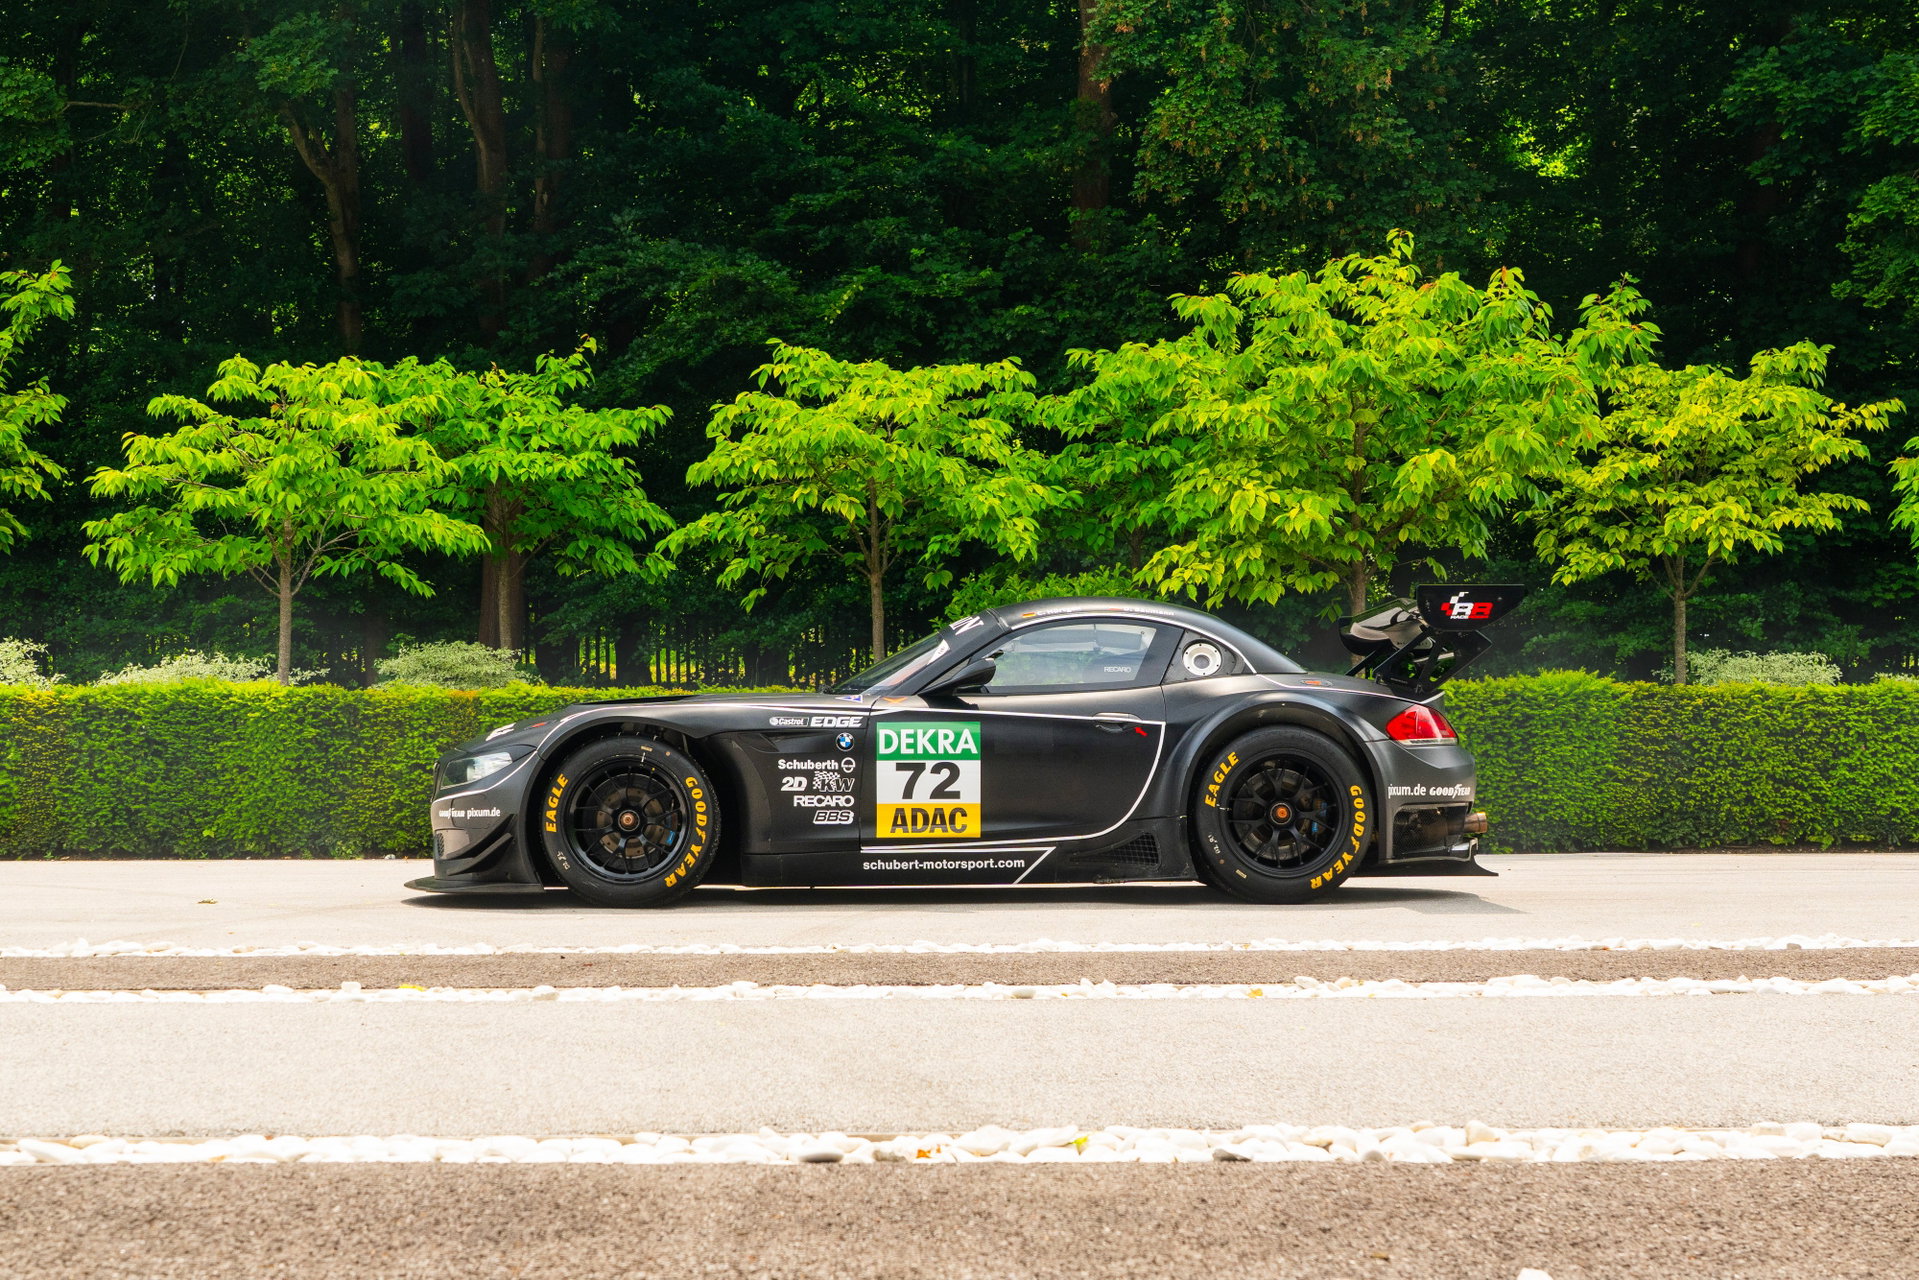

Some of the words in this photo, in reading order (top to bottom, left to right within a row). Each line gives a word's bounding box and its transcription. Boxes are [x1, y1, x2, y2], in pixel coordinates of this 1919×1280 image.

[778, 717, 804, 726] Castrol
[810, 716, 864, 728] EDGE
[878, 728, 978, 755] DEKRA
[777, 758, 839, 770] Schuberth
[780, 776, 808, 792] 2D
[819, 777, 855, 792] KW
[895, 761, 961, 800] 72
[1204, 751, 1240, 808] EAGLE
[545, 773, 569, 833] EAGLE
[793, 795, 855, 807] RECARO
[466, 806, 501, 820] pixum.de
[813, 810, 853, 824] BBS
[890, 807, 968, 834] ADAC
[664, 776, 708, 888] GOODYEAR
[1309, 785, 1367, 890] GOODYEAR
[862, 858, 1026, 871] schubert-motorsport.com
